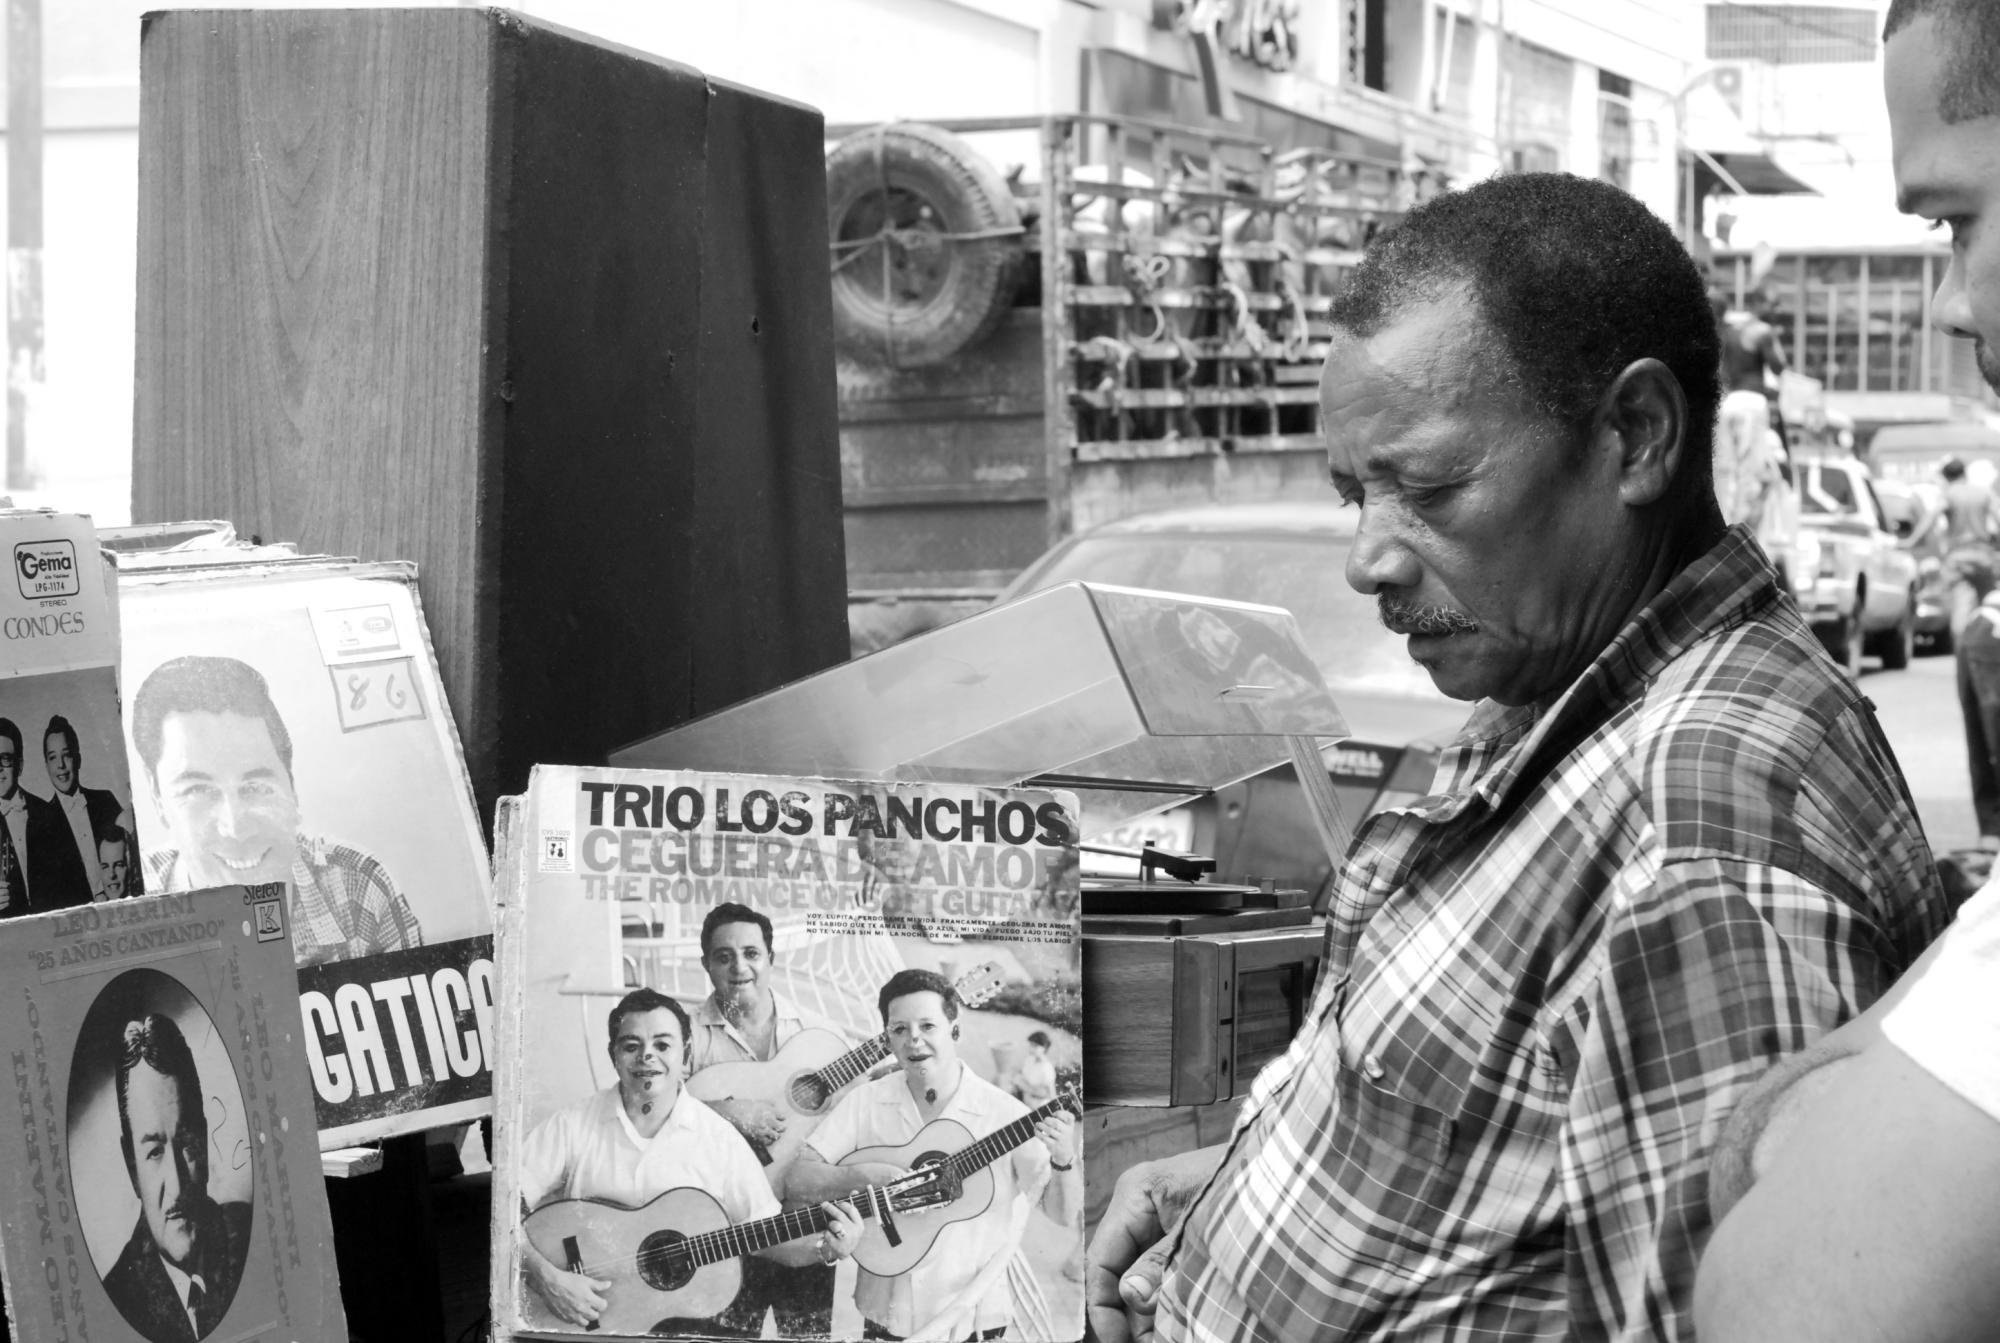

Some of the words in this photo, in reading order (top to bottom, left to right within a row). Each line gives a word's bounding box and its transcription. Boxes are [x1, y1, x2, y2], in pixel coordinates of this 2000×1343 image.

[19, 553, 72, 580] Gema
[35, 581, 65, 593] LPG-1174
[40, 600, 67, 608] STEREO
[4, 611, 85, 640] CONDES
[581, 781, 705, 832] TRIO
[715, 788, 814, 836] LOS
[823, 792, 1071, 847] PANCHOS
[581, 828, 832, 882] CEGUERA
[835, 838, 907, 886] DE
[242, 881, 280, 906] Stereo
[580, 873, 643, 901] THE
[649, 876, 810, 909] ROMANCE
[814, 883, 857, 911] OF
[52, 905, 100, 938] LEO
[60, 938, 113, 967] AÑOS
